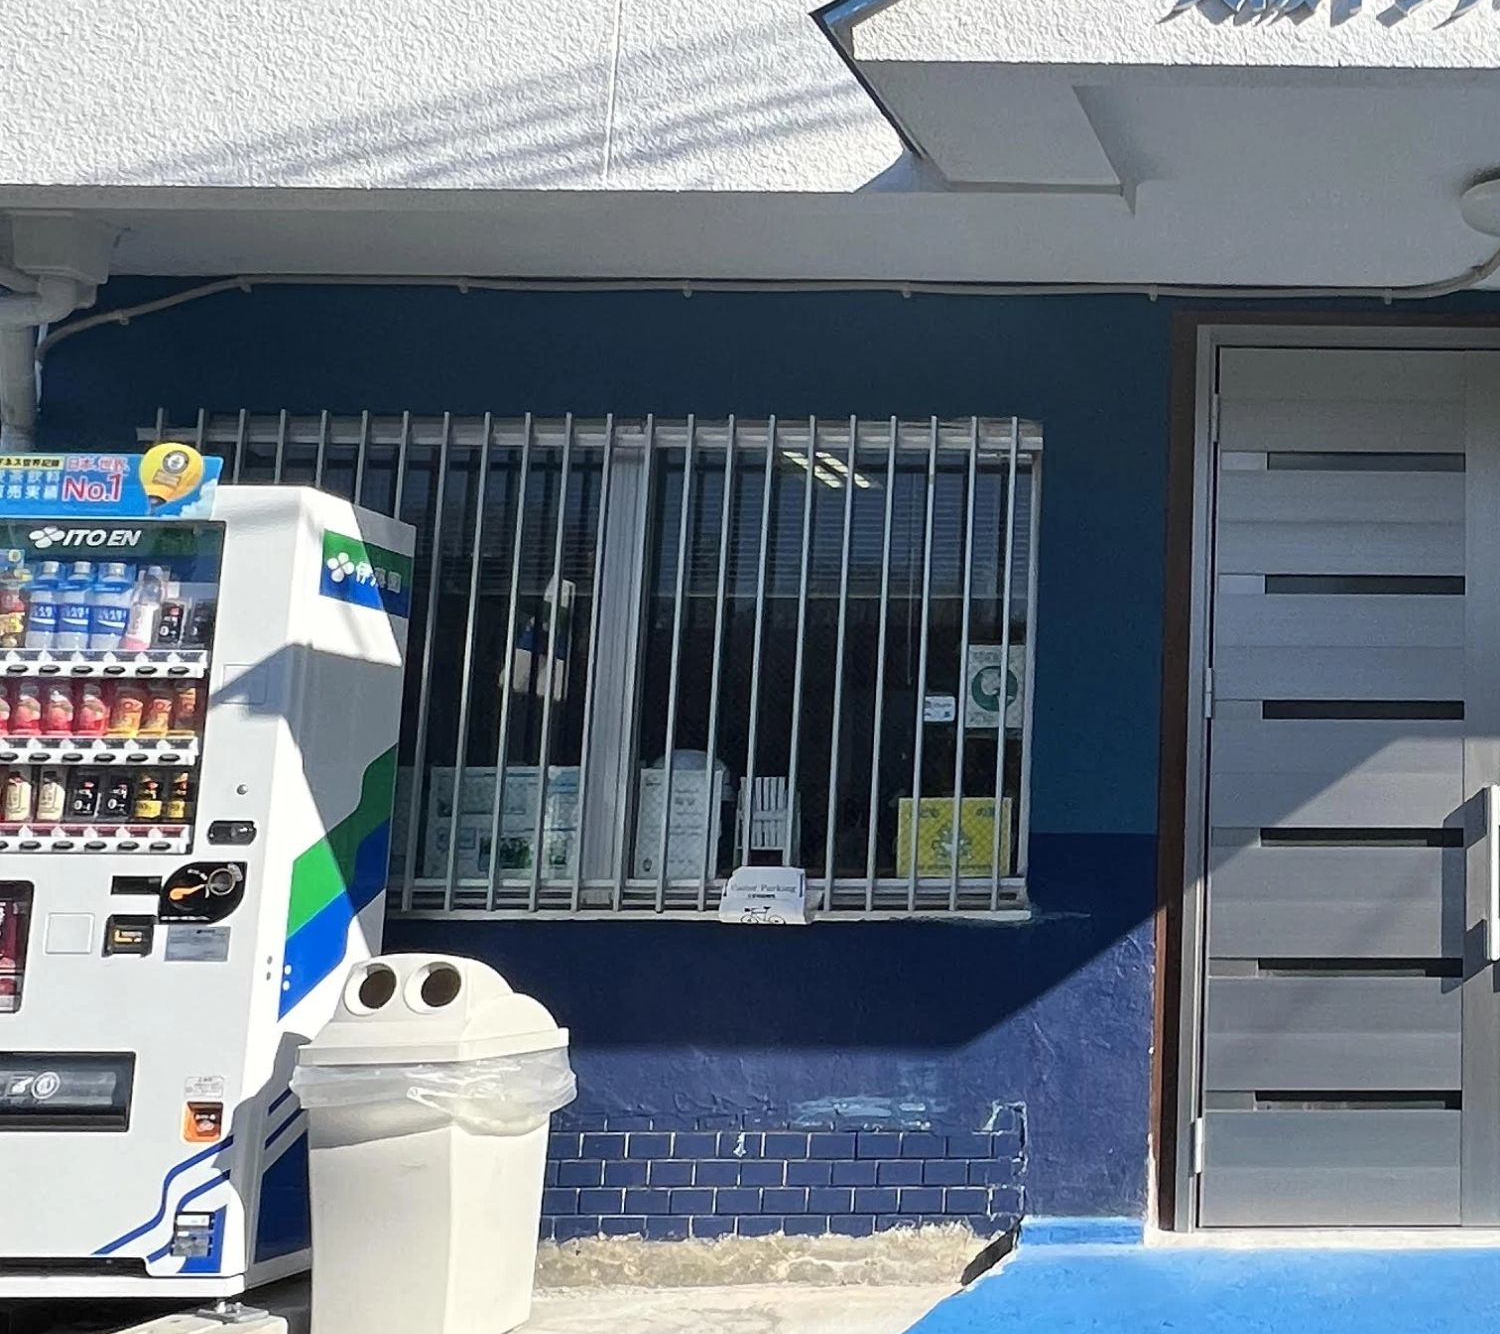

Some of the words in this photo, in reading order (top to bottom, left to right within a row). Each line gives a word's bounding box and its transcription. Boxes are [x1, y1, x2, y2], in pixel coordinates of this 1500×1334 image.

[62, 473, 123, 502] No.1
[62, 530, 107, 547] ITO
[107, 530, 142, 547] EN
